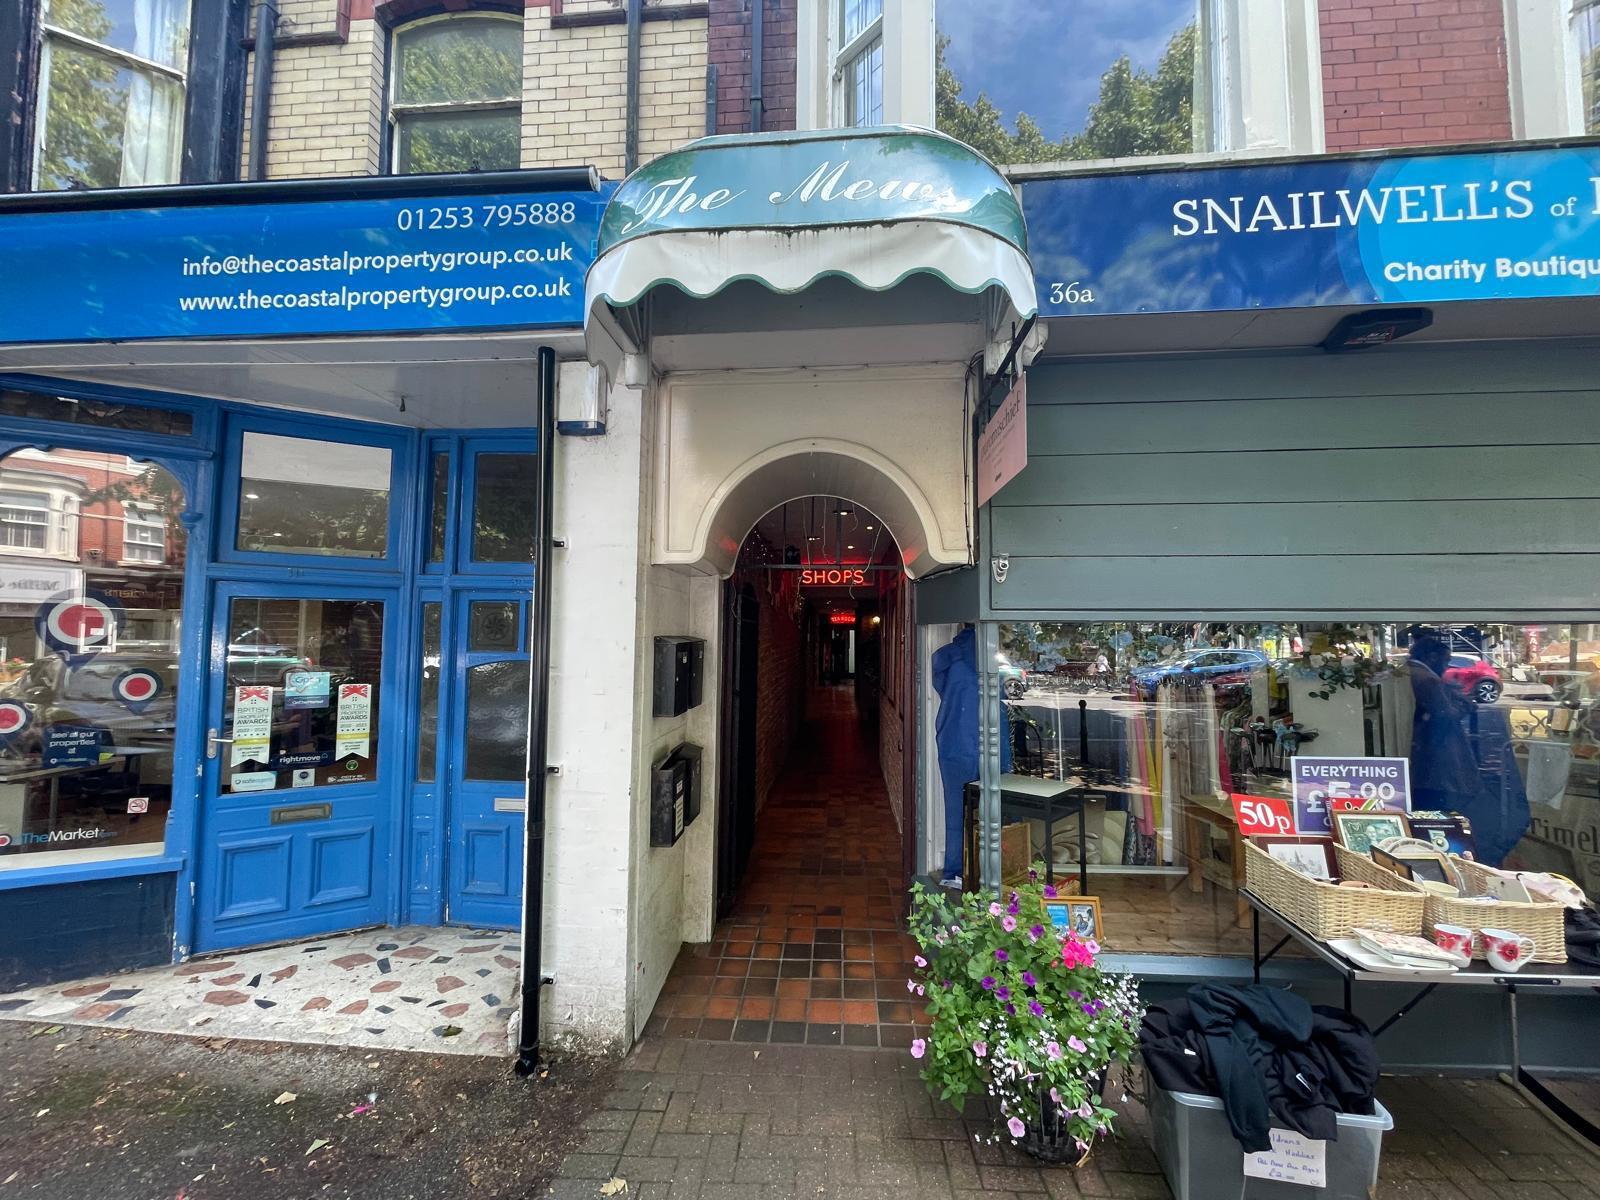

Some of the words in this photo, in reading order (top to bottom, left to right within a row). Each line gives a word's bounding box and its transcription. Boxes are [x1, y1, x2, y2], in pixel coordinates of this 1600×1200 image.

[620, 174, 747, 235] The
[1172, 180, 1534, 236] SNAILWELL'S
[1550, 197, 1577, 216] of
[396, 206, 474, 231] 01253
[482, 202, 576, 227] 795888
[183, 241, 573, 276] info@thecoastalpropertygroup.co.uk
[1384, 259, 1486, 283] Charity
[179, 276, 571, 311] www.thecoastalpropertygroup.co.uk
[1049, 281, 1095, 304] 36a
[802, 570, 864, 584] SHOPS
[340, 703, 368, 711] BRITISH
[49, 739, 96, 747] properties
[67, 746, 77, 754] at
[279, 755, 321, 765] rightmove
[1301, 765, 1398, 778] EVERYTHING
[1240, 801, 1291, 834] 50p
